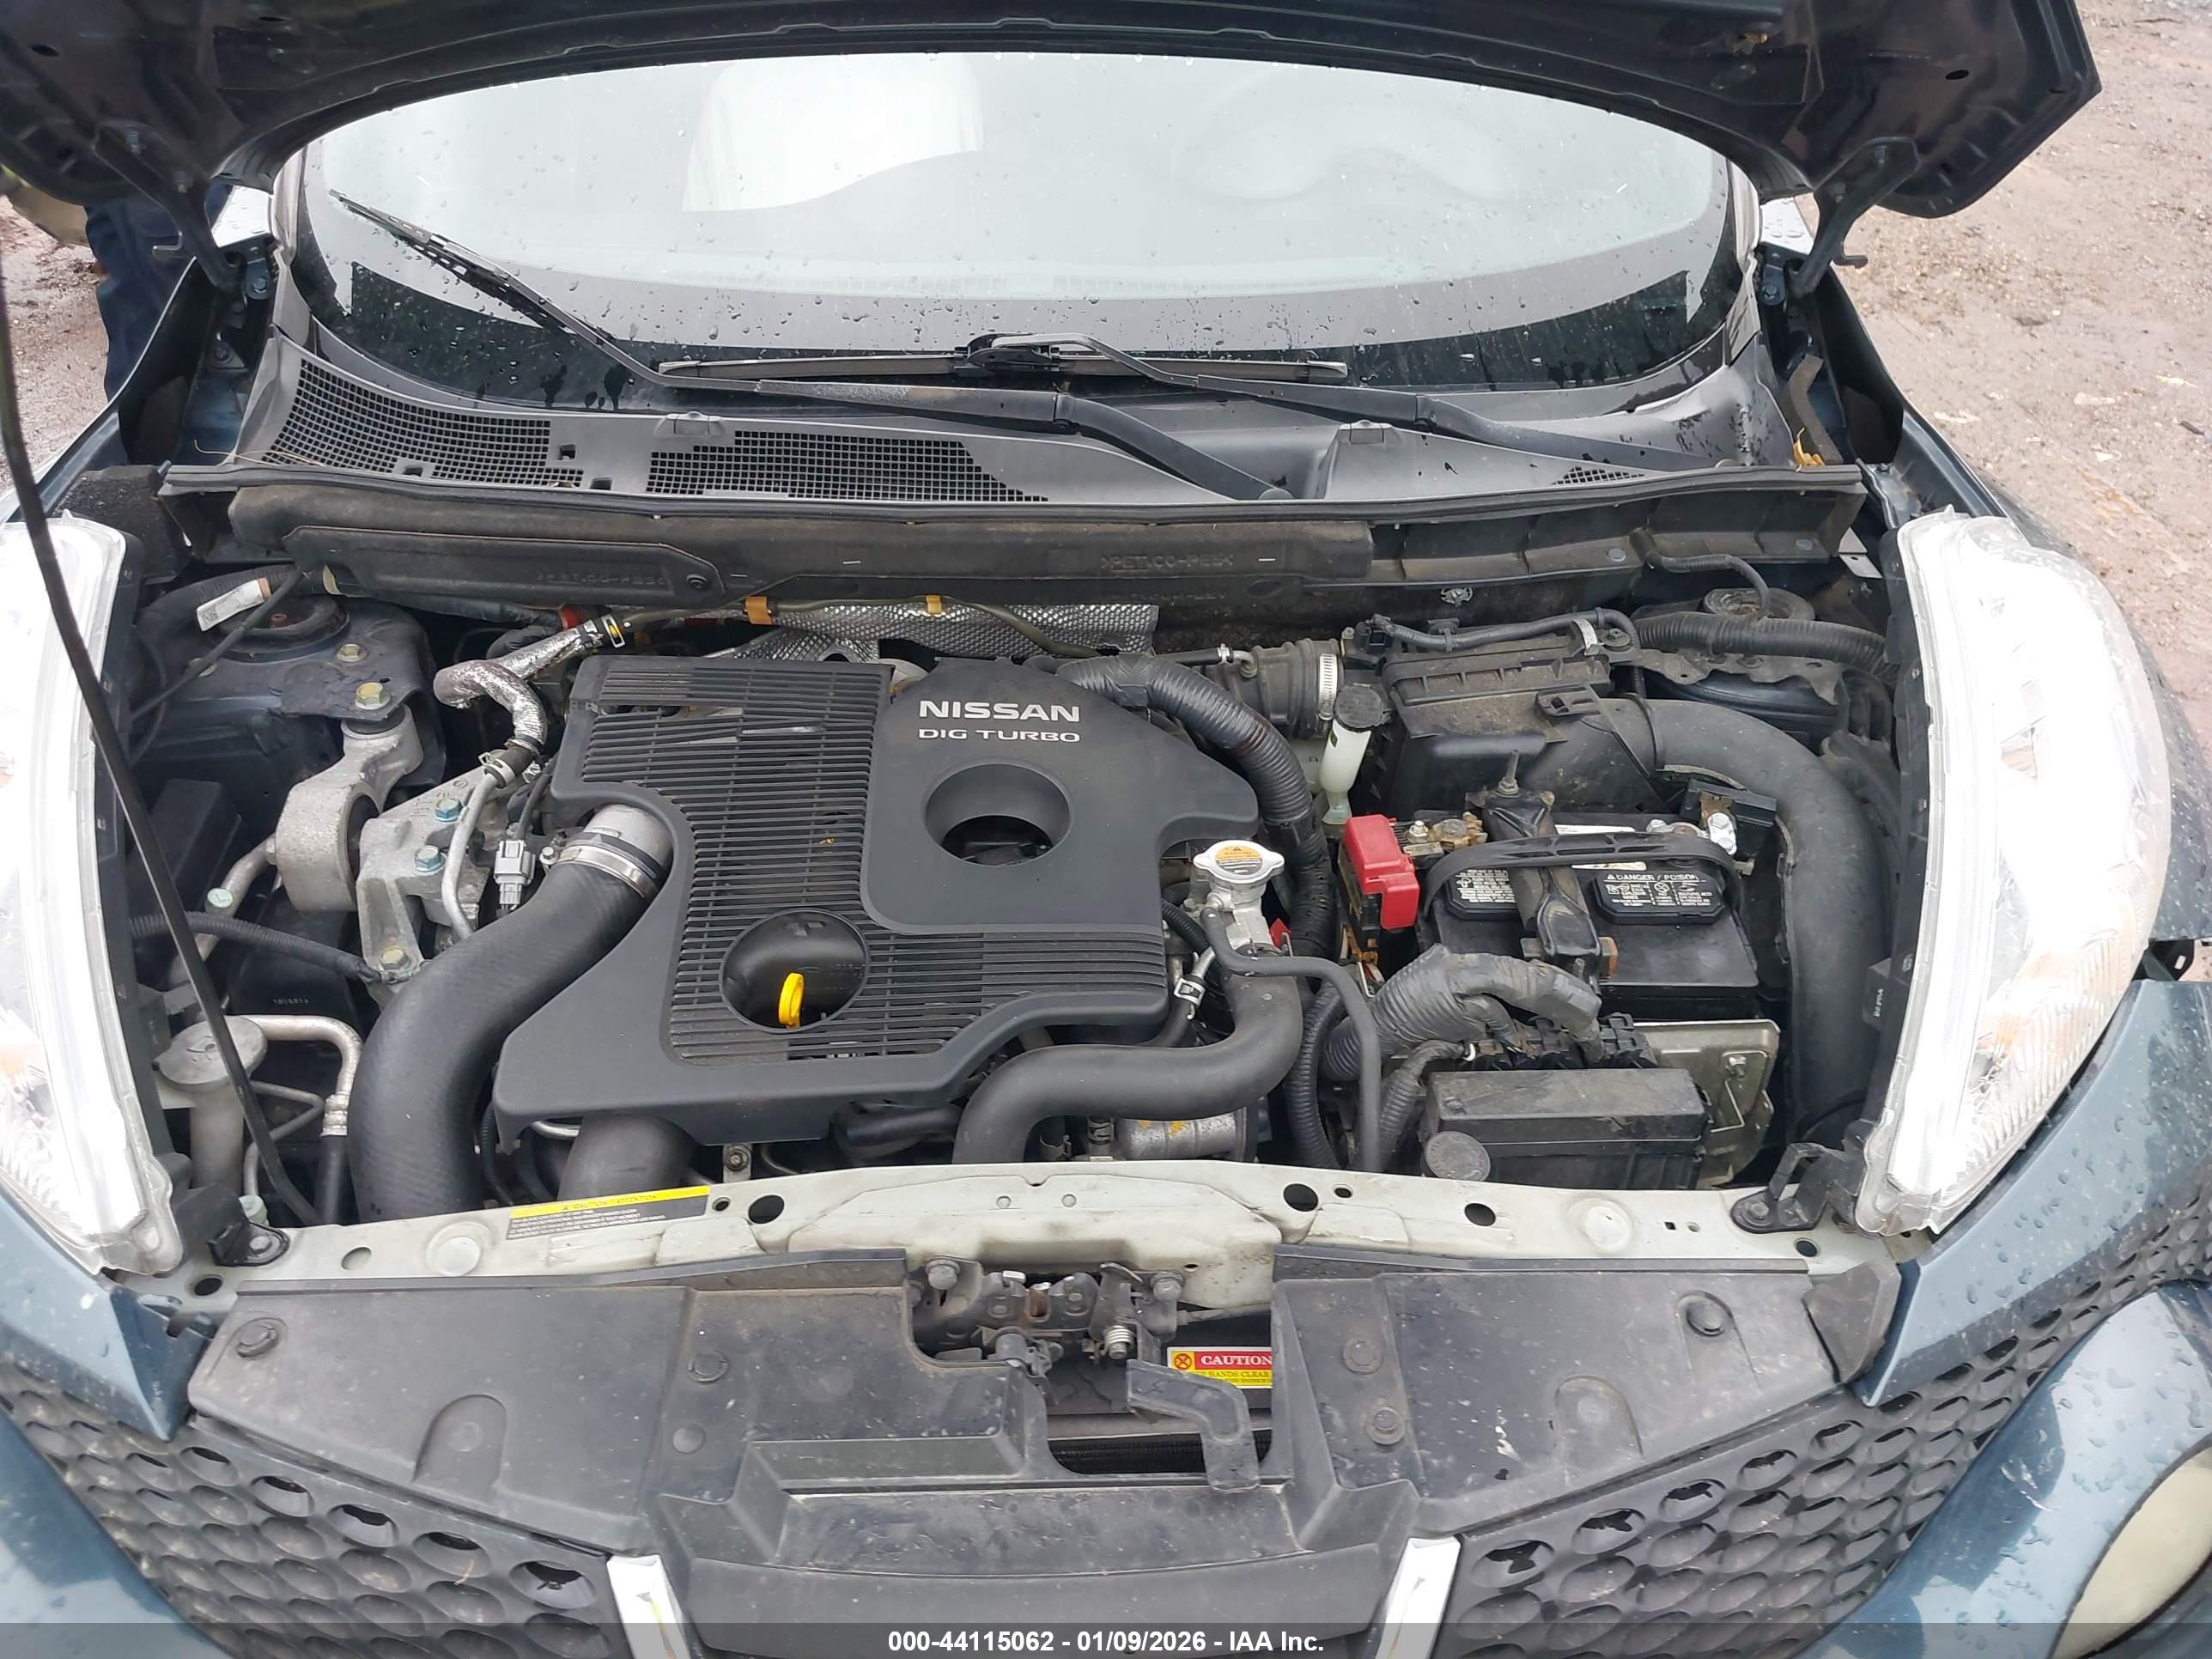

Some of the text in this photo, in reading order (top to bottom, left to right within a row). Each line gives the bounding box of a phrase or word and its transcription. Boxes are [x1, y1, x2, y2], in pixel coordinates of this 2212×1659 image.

[919, 700, 1080, 722] NISSAN
[919, 728, 1080, 743] DIG TURBO
[1200, 1355, 1273, 1366] CAUTION
